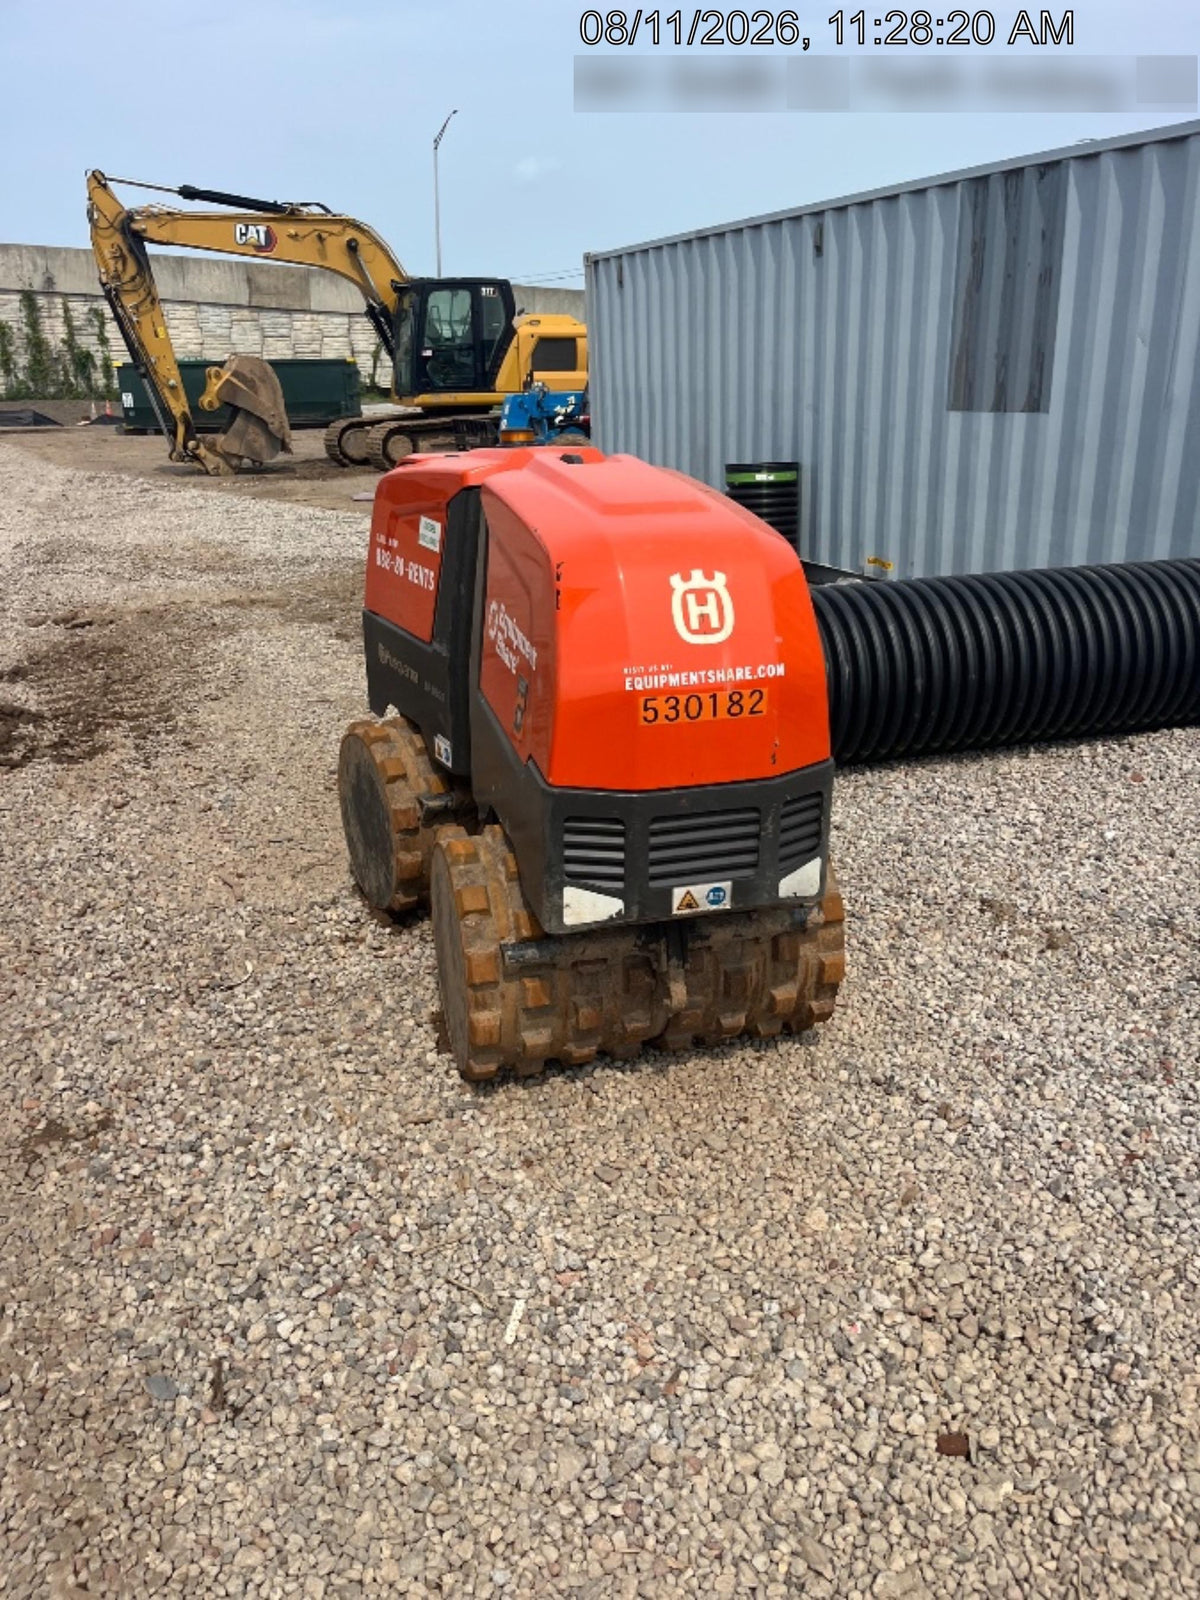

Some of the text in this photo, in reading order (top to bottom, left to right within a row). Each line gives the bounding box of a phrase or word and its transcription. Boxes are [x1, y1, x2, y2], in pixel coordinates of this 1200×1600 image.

[235, 224, 267, 246] CAT
[624, 663, 786, 691] EQUIPMENTSHARE.COM
[642, 689, 764, 723] 530182
